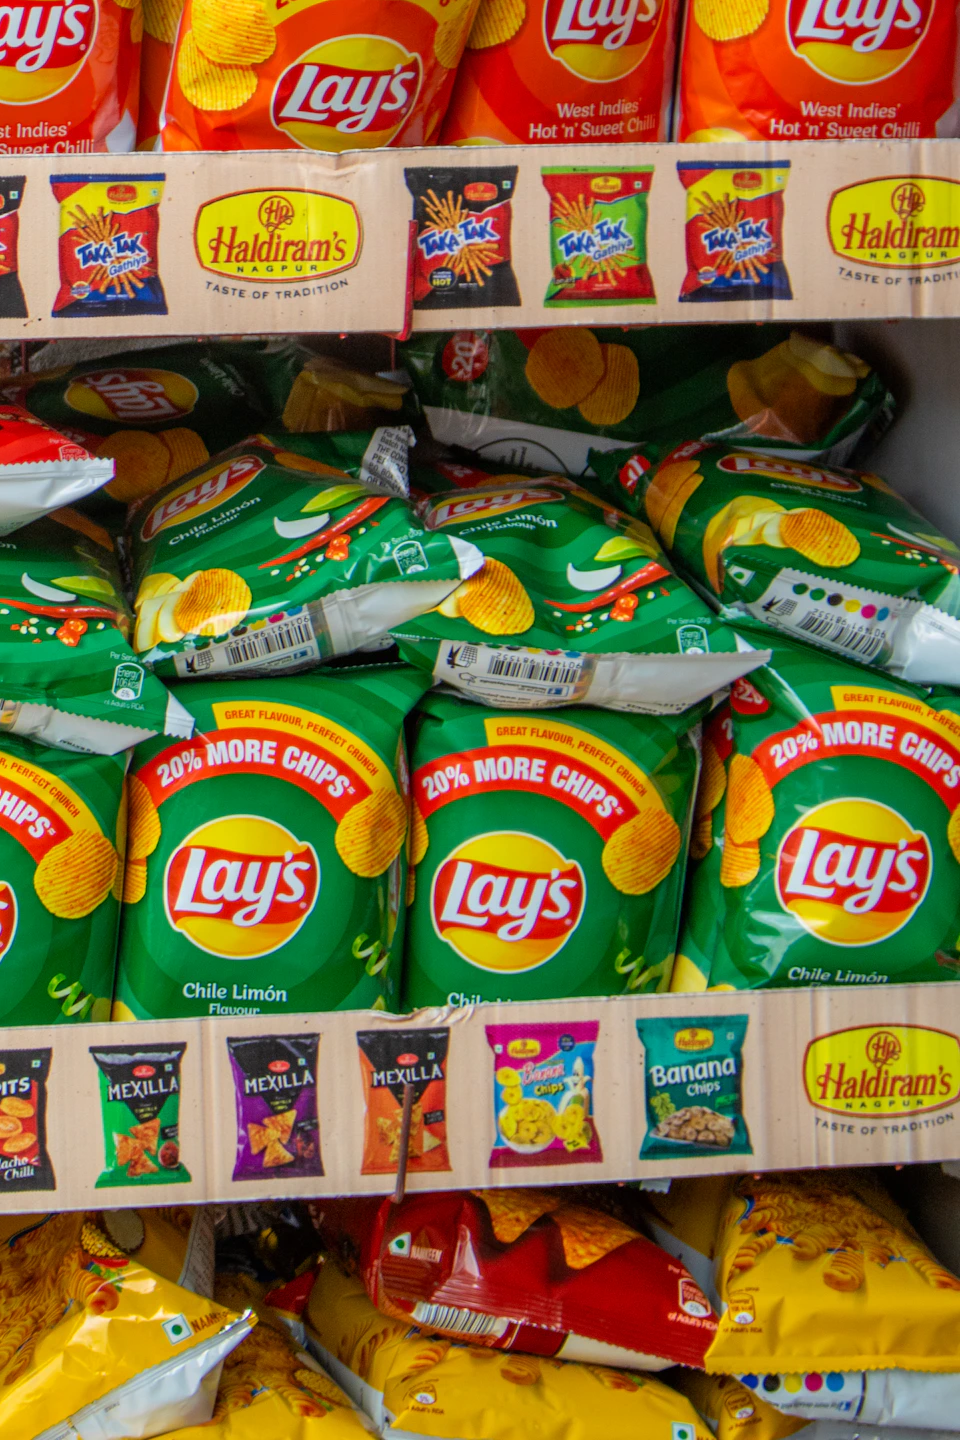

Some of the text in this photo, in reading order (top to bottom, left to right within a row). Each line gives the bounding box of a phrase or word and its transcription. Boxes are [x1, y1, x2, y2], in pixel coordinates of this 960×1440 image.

[279, 63, 416, 133] Lay's
[799, 100, 846, 120] West
[769, 118, 800, 137] Hot
[828, 121, 879, 138] Sweet
[883, 121, 921, 139] Chilli
[208, 226, 348, 265] Haldiram's
[156, 747, 202, 788] 20%
[205, 738, 278, 767] MORE
[10, 761, 50, 790] PERFECT
[48, 786, 81, 819] CRUNCH
[785, 829, 924, 915] Lay's
[173, 847, 311, 928] Lay's
[440, 861, 578, 942] Lay's
[787, 967, 889, 984] Chile Limón
[182, 982, 287, 1002] Chile Limón
[244, 1070, 314, 1094] MEXILLA
[372, 1063, 443, 1087] MEXILLA
[651, 1057, 737, 1088] Banana
[816, 1063, 952, 1100] Haldiram's
[108, 1078, 179, 1101] MEXILLA
[686, 1080, 721, 1097] Chips
[845, 1099, 926, 1109] NAGPUR
[814, 1113, 956, 1135] TASTE OF TRADITION
[3, 1166, 35, 1181] Chilli
